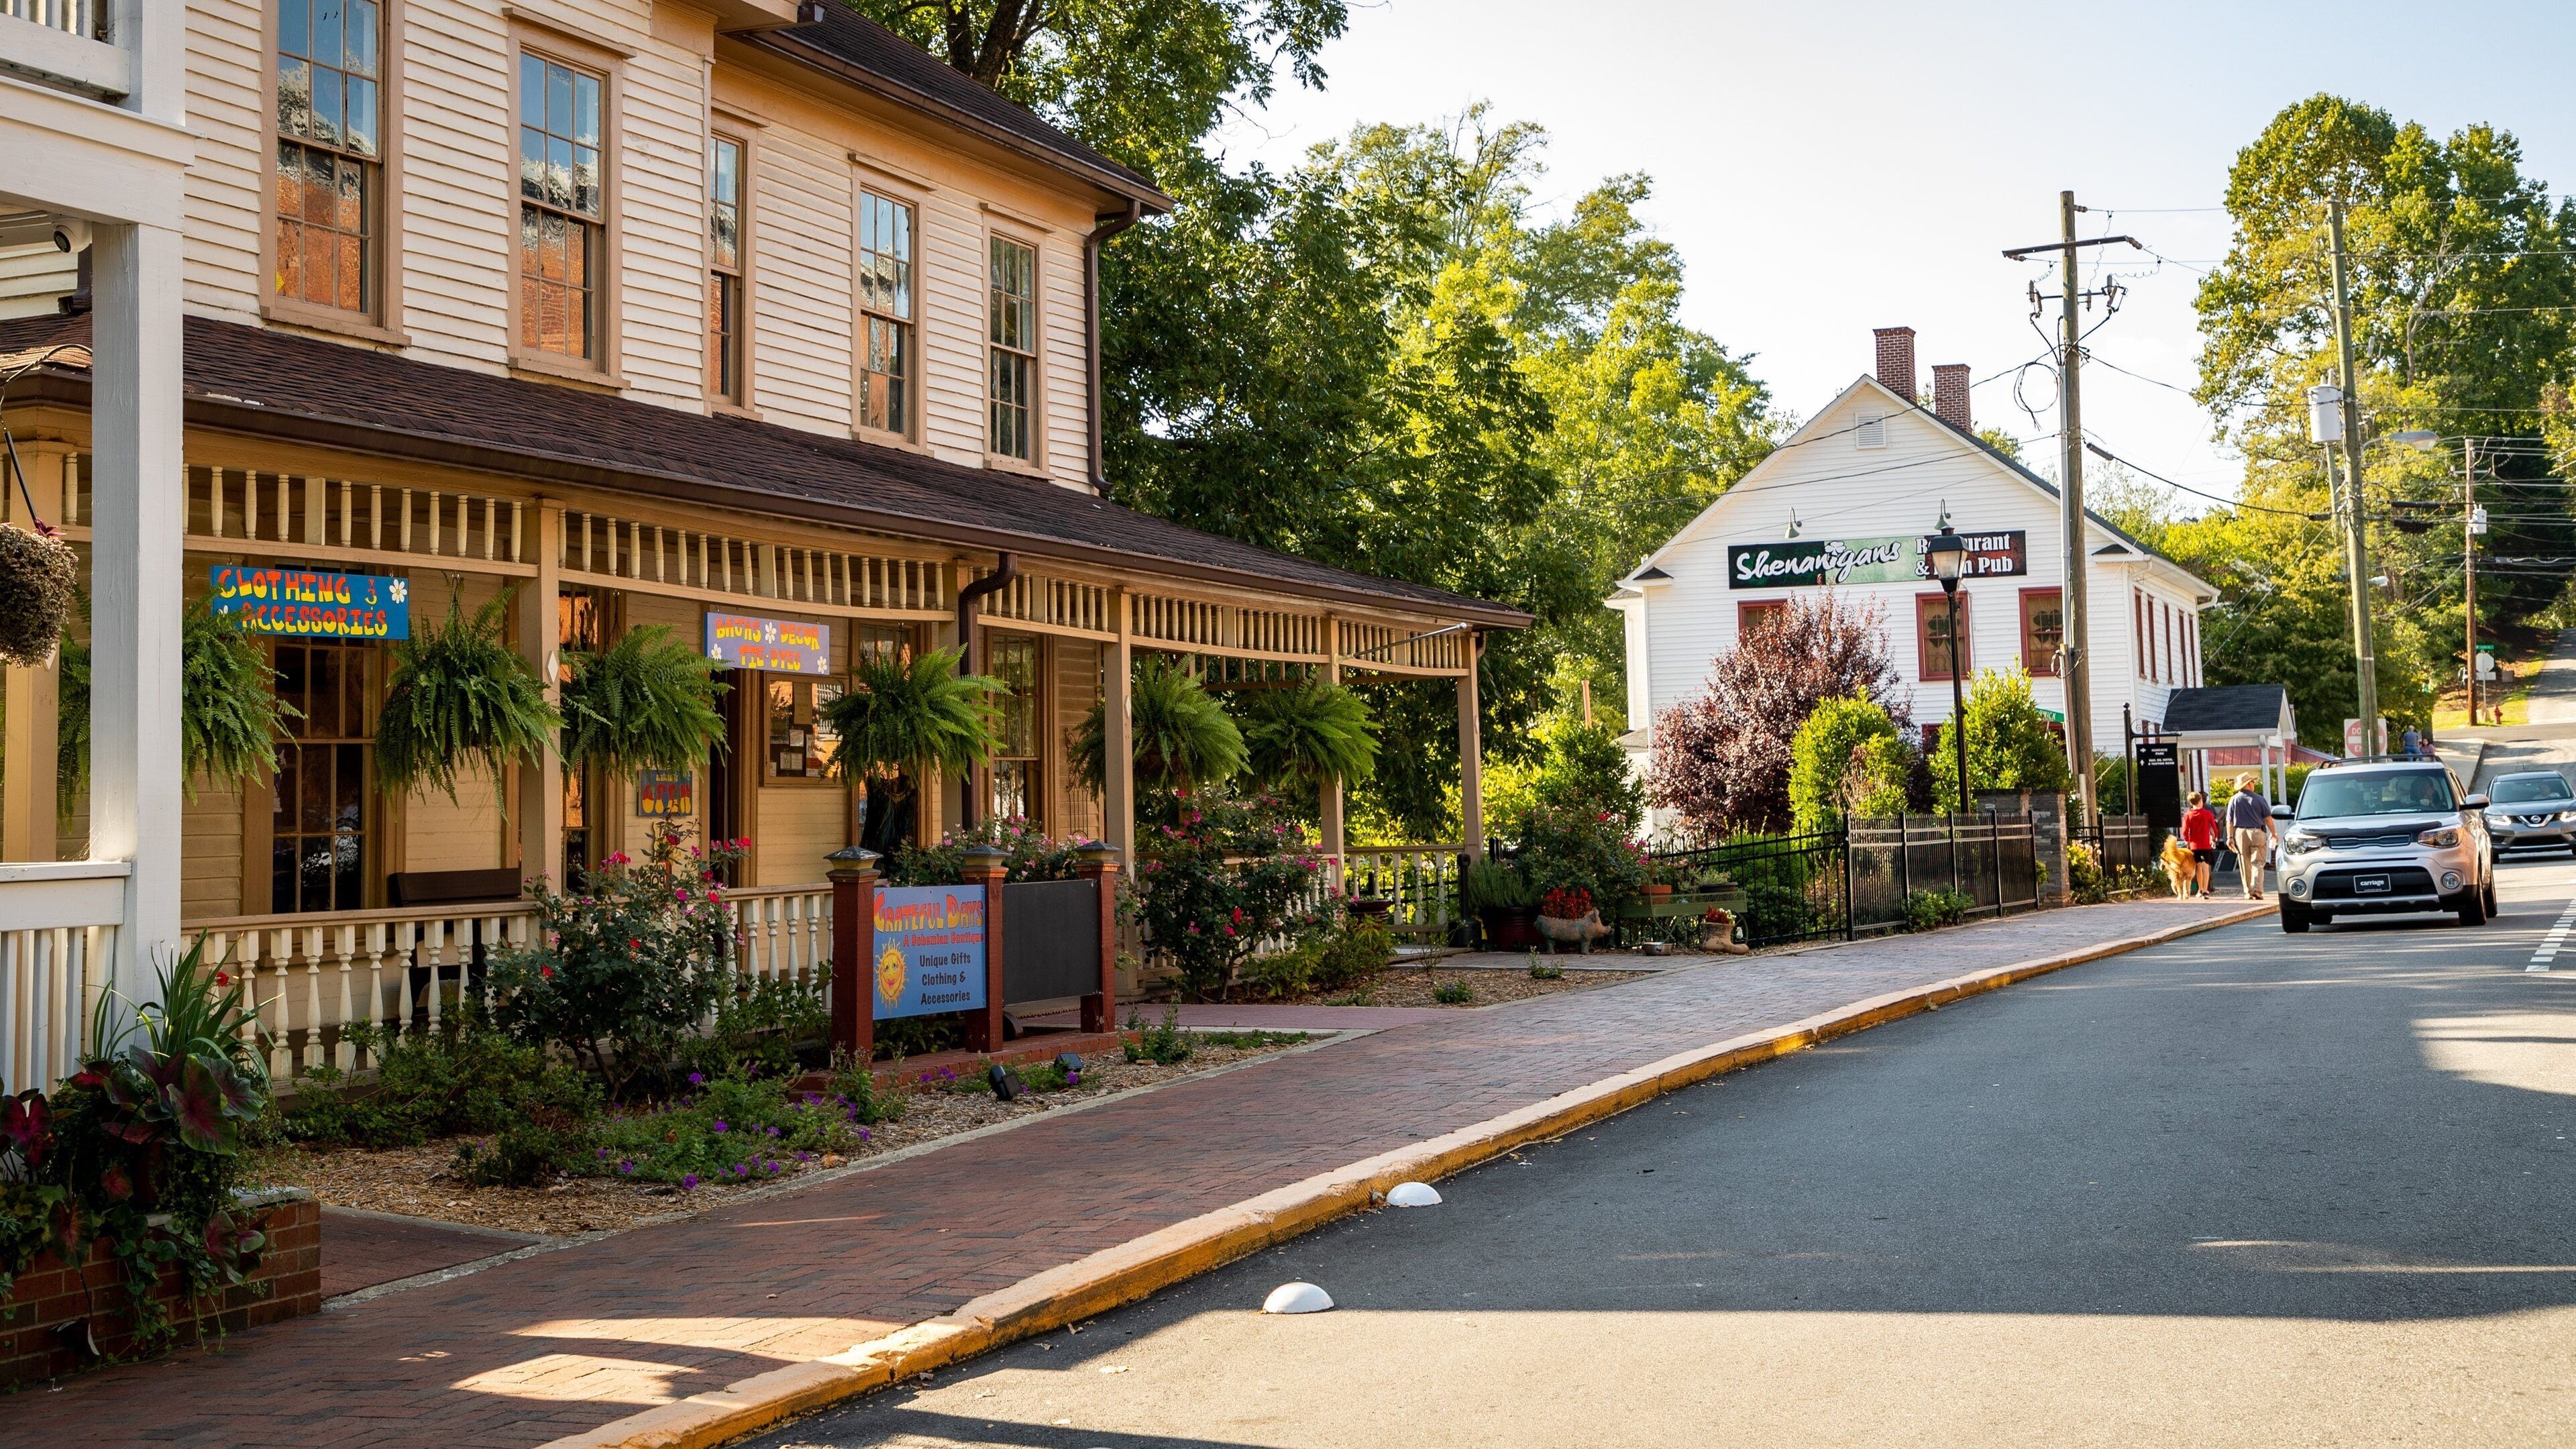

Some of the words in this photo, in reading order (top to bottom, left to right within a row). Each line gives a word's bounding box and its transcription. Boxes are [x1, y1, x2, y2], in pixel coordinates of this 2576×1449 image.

[1916, 533, 2010, 555] Rurant
[1736, 541, 1901, 583] Shenanigans
[1915, 560, 1930, 576] &
[1978, 555, 2012, 574] Pub
[218, 569, 351, 604] CLOTHING
[242, 602, 388, 637] ACCESSORIES
[780, 622, 820, 651] DECOR
[874, 891, 944, 932] GRATEFUL
[947, 894, 983, 928] DAYS
[903, 934, 909, 947] A
[920, 954, 948, 967] Unique
[951, 952, 971, 965] Gifts
[922, 973, 957, 986] Clothing
[959, 971, 966, 983] &
[920, 990, 970, 1006] Accessories
